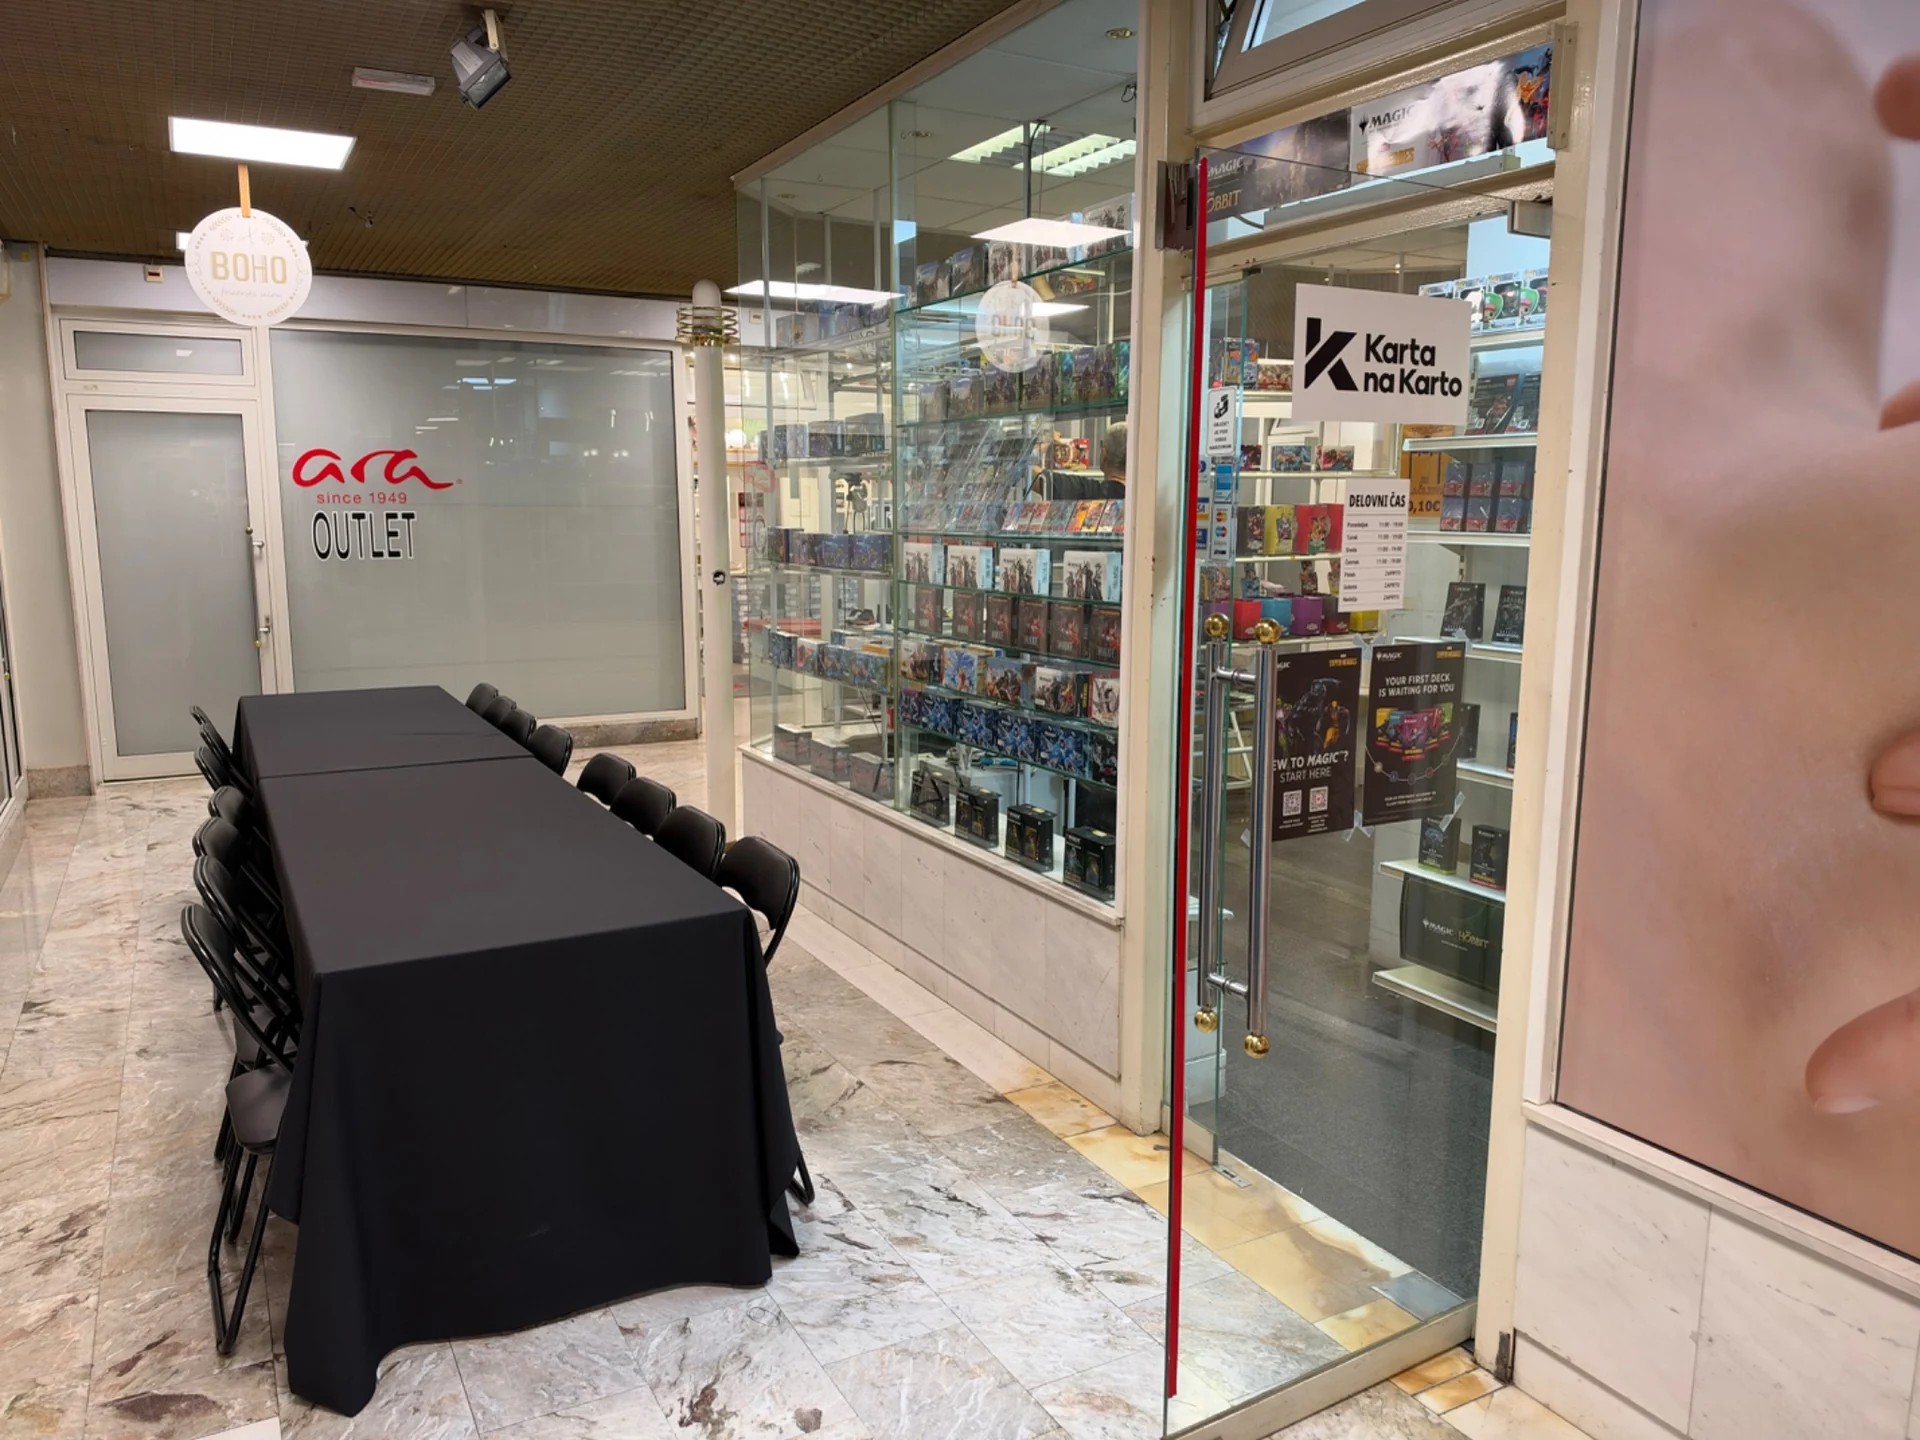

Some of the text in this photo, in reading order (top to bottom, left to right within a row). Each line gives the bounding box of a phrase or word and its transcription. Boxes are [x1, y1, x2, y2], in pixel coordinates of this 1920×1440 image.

[1368, 104, 1415, 129] MAGIC
[1207, 189, 1243, 213] OBBIT
[210, 251, 287, 285] BOHO
[1364, 333, 1436, 367] Karta
[1363, 371, 1395, 393] na
[1399, 367, 1463, 397] Karto
[292, 448, 455, 490] ara
[316, 491, 408, 504] since 1949
[1349, 491, 1406, 508] DELOVNI ČAS
[312, 511, 417, 561] OUTLET
[1385, 673, 1450, 686] YOUR FIRST DECK
[1379, 683, 1455, 697] IS WAITING FOR YOU
[1272, 758, 1288, 771] EW
[1291, 756, 1304, 768] TO
[1280, 767, 1332, 783] START HERE
[1428, 921, 1454, 935] MAGIC
